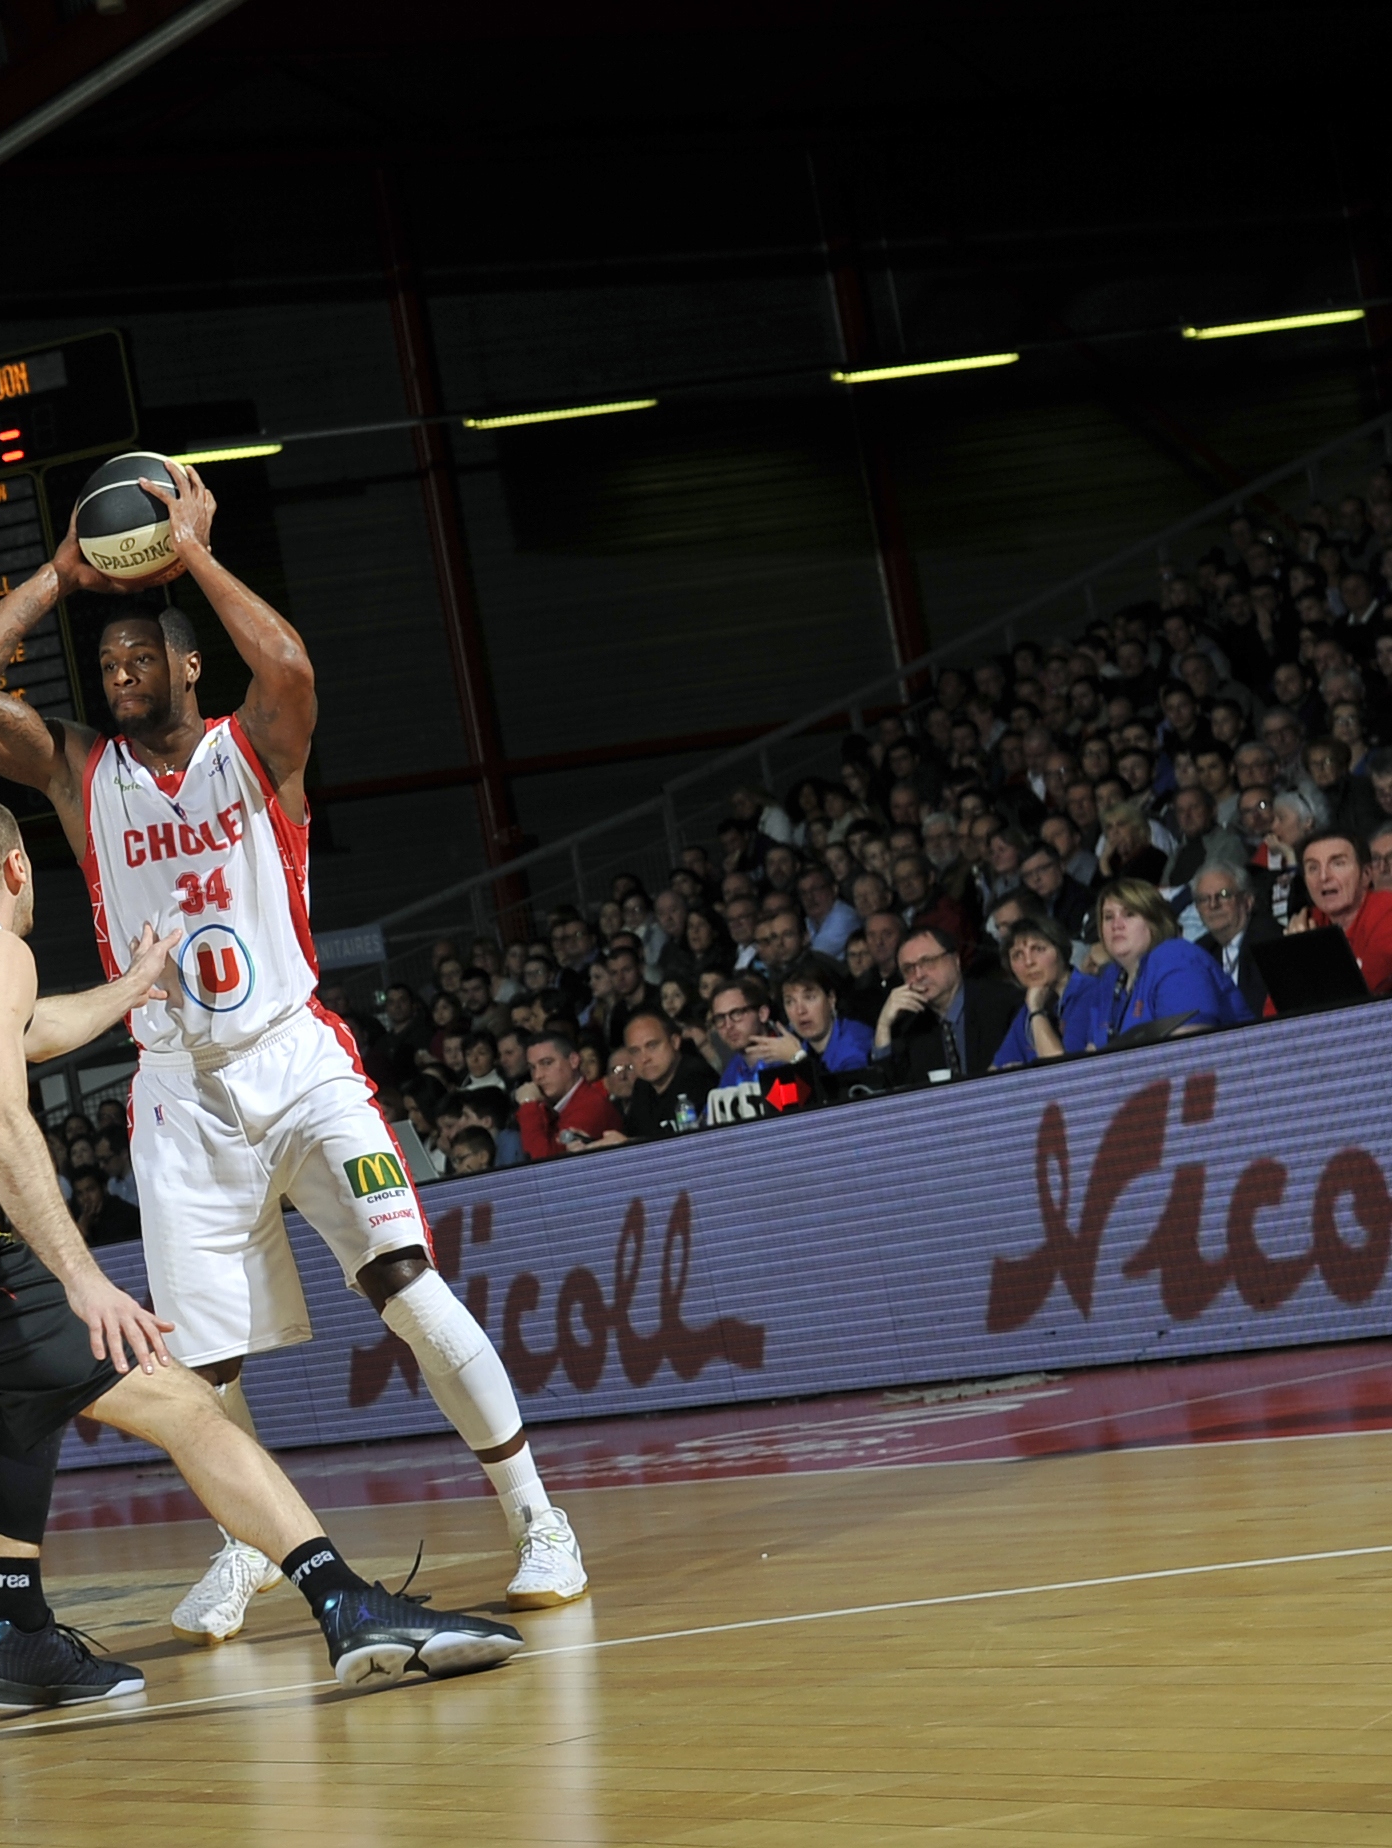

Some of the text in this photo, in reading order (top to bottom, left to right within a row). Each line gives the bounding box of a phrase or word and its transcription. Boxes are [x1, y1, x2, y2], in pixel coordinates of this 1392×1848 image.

[123, 800, 243, 869] CHOLE
[175, 865, 233, 916] 34
[196, 946, 240, 994] U
[367, 1189, 406, 1204] CHOLET
[368, 1208, 415, 1229] SPALDING
